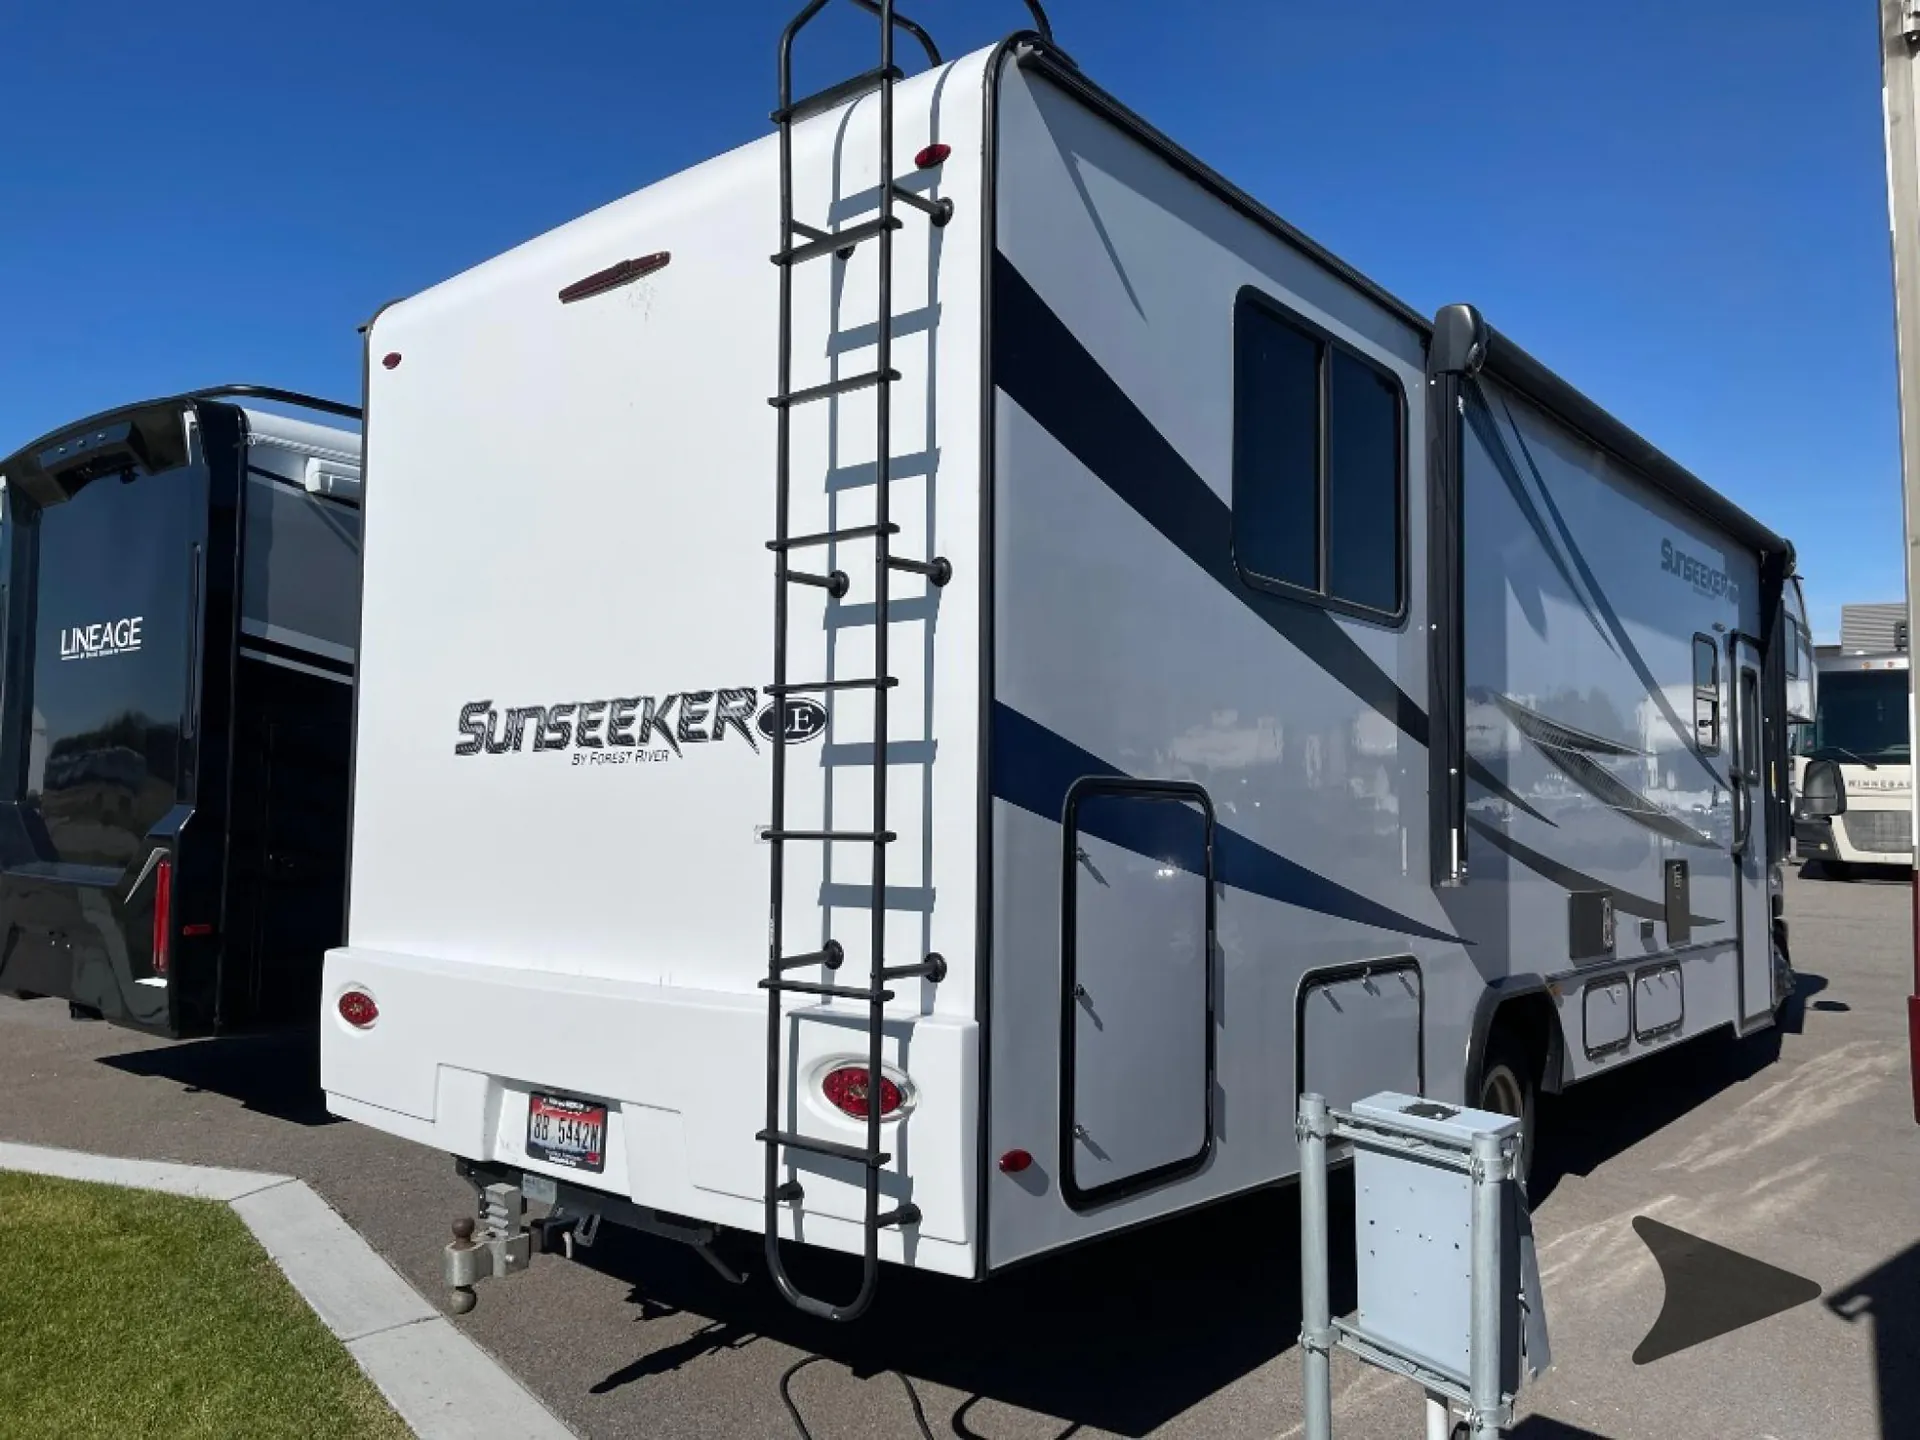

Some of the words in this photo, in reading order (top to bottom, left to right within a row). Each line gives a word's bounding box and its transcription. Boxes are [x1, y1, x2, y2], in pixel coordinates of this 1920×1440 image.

[61, 616, 143, 655] LINEAGE
[572, 752, 588, 766] BY
[590, 751, 632, 766] FOREST
[635, 749, 671, 764] RIVER
